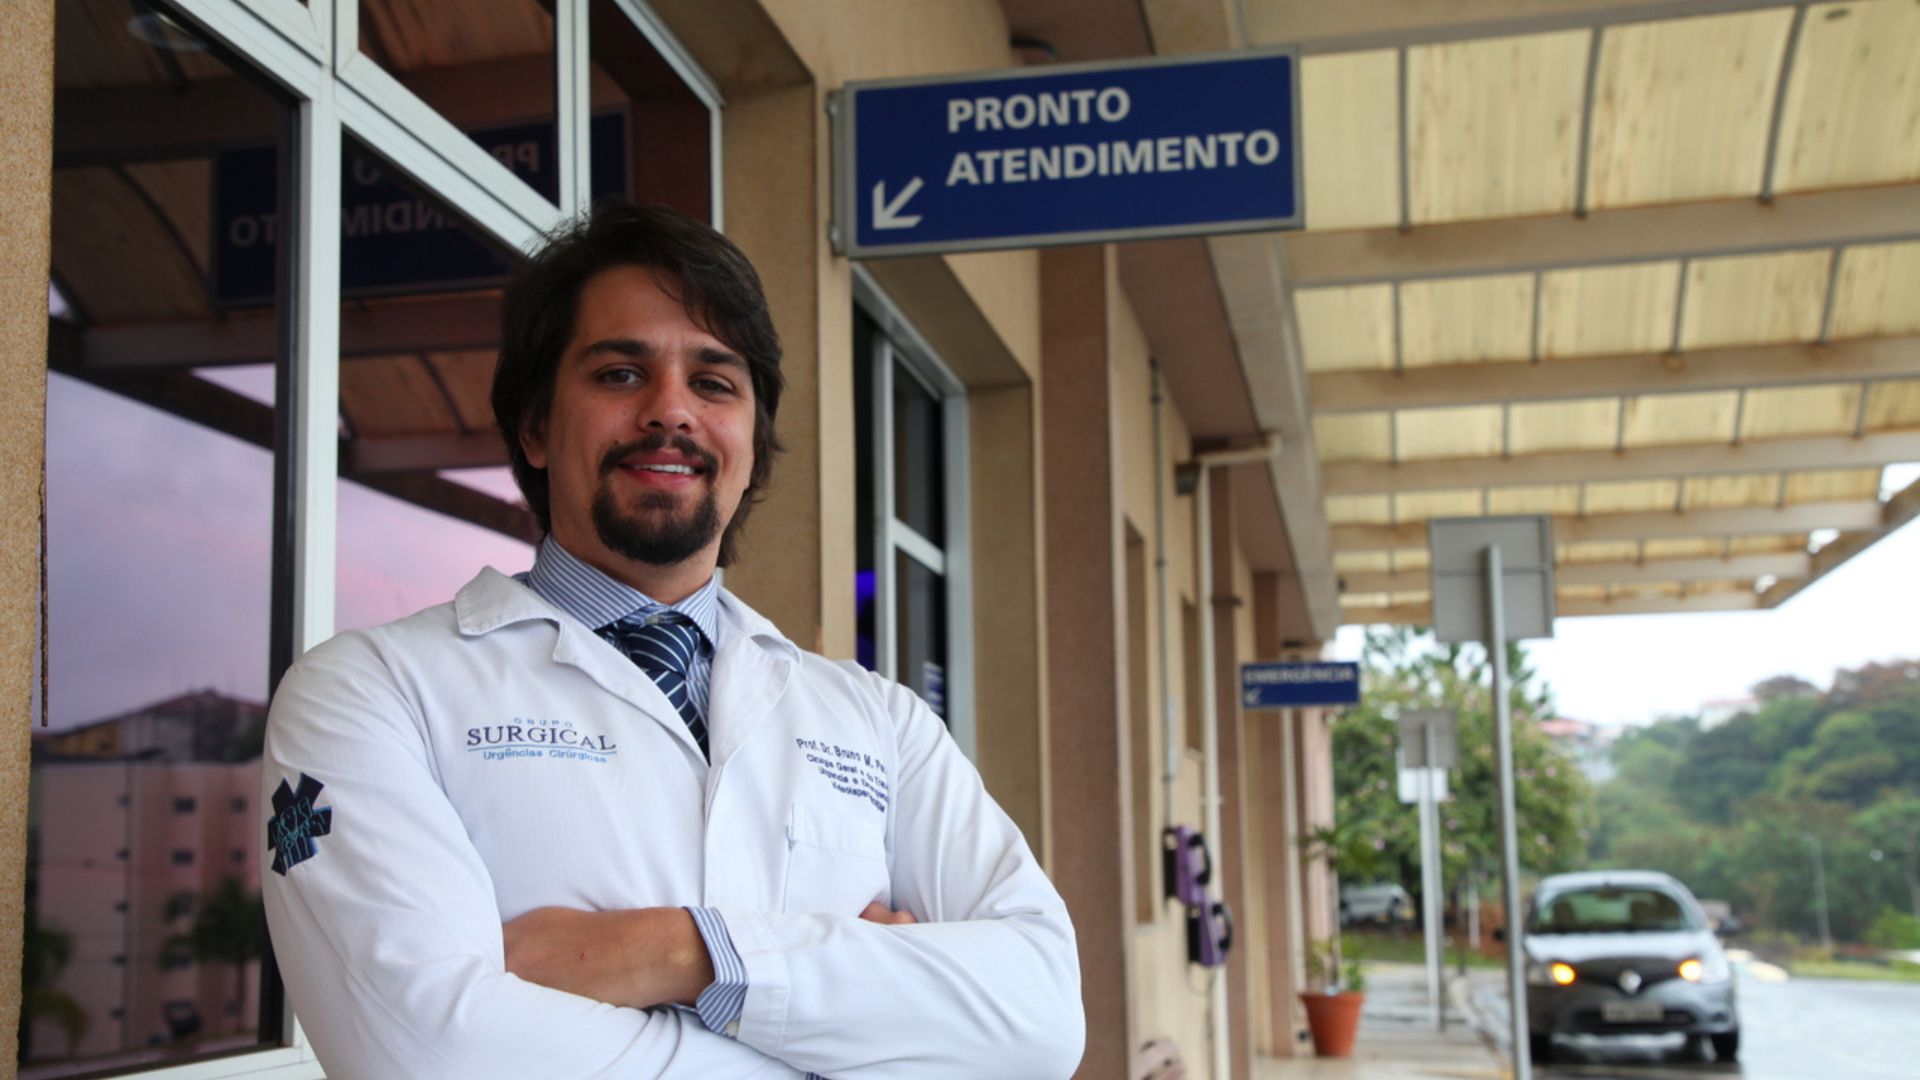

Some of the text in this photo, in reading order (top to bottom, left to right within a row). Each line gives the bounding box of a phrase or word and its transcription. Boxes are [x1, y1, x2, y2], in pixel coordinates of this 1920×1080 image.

[947, 87, 1131, 134] PRONTO
[945, 129, 1280, 187] ATENDIMENTO
[466, 725, 617, 750] SURGICAL
[796, 738, 819, 751] Prof.
[820, 741, 834, 756] Dr.
[834, 745, 861, 762] Bruno
[483, 748, 608, 763] Urgências Cirúrgicas
